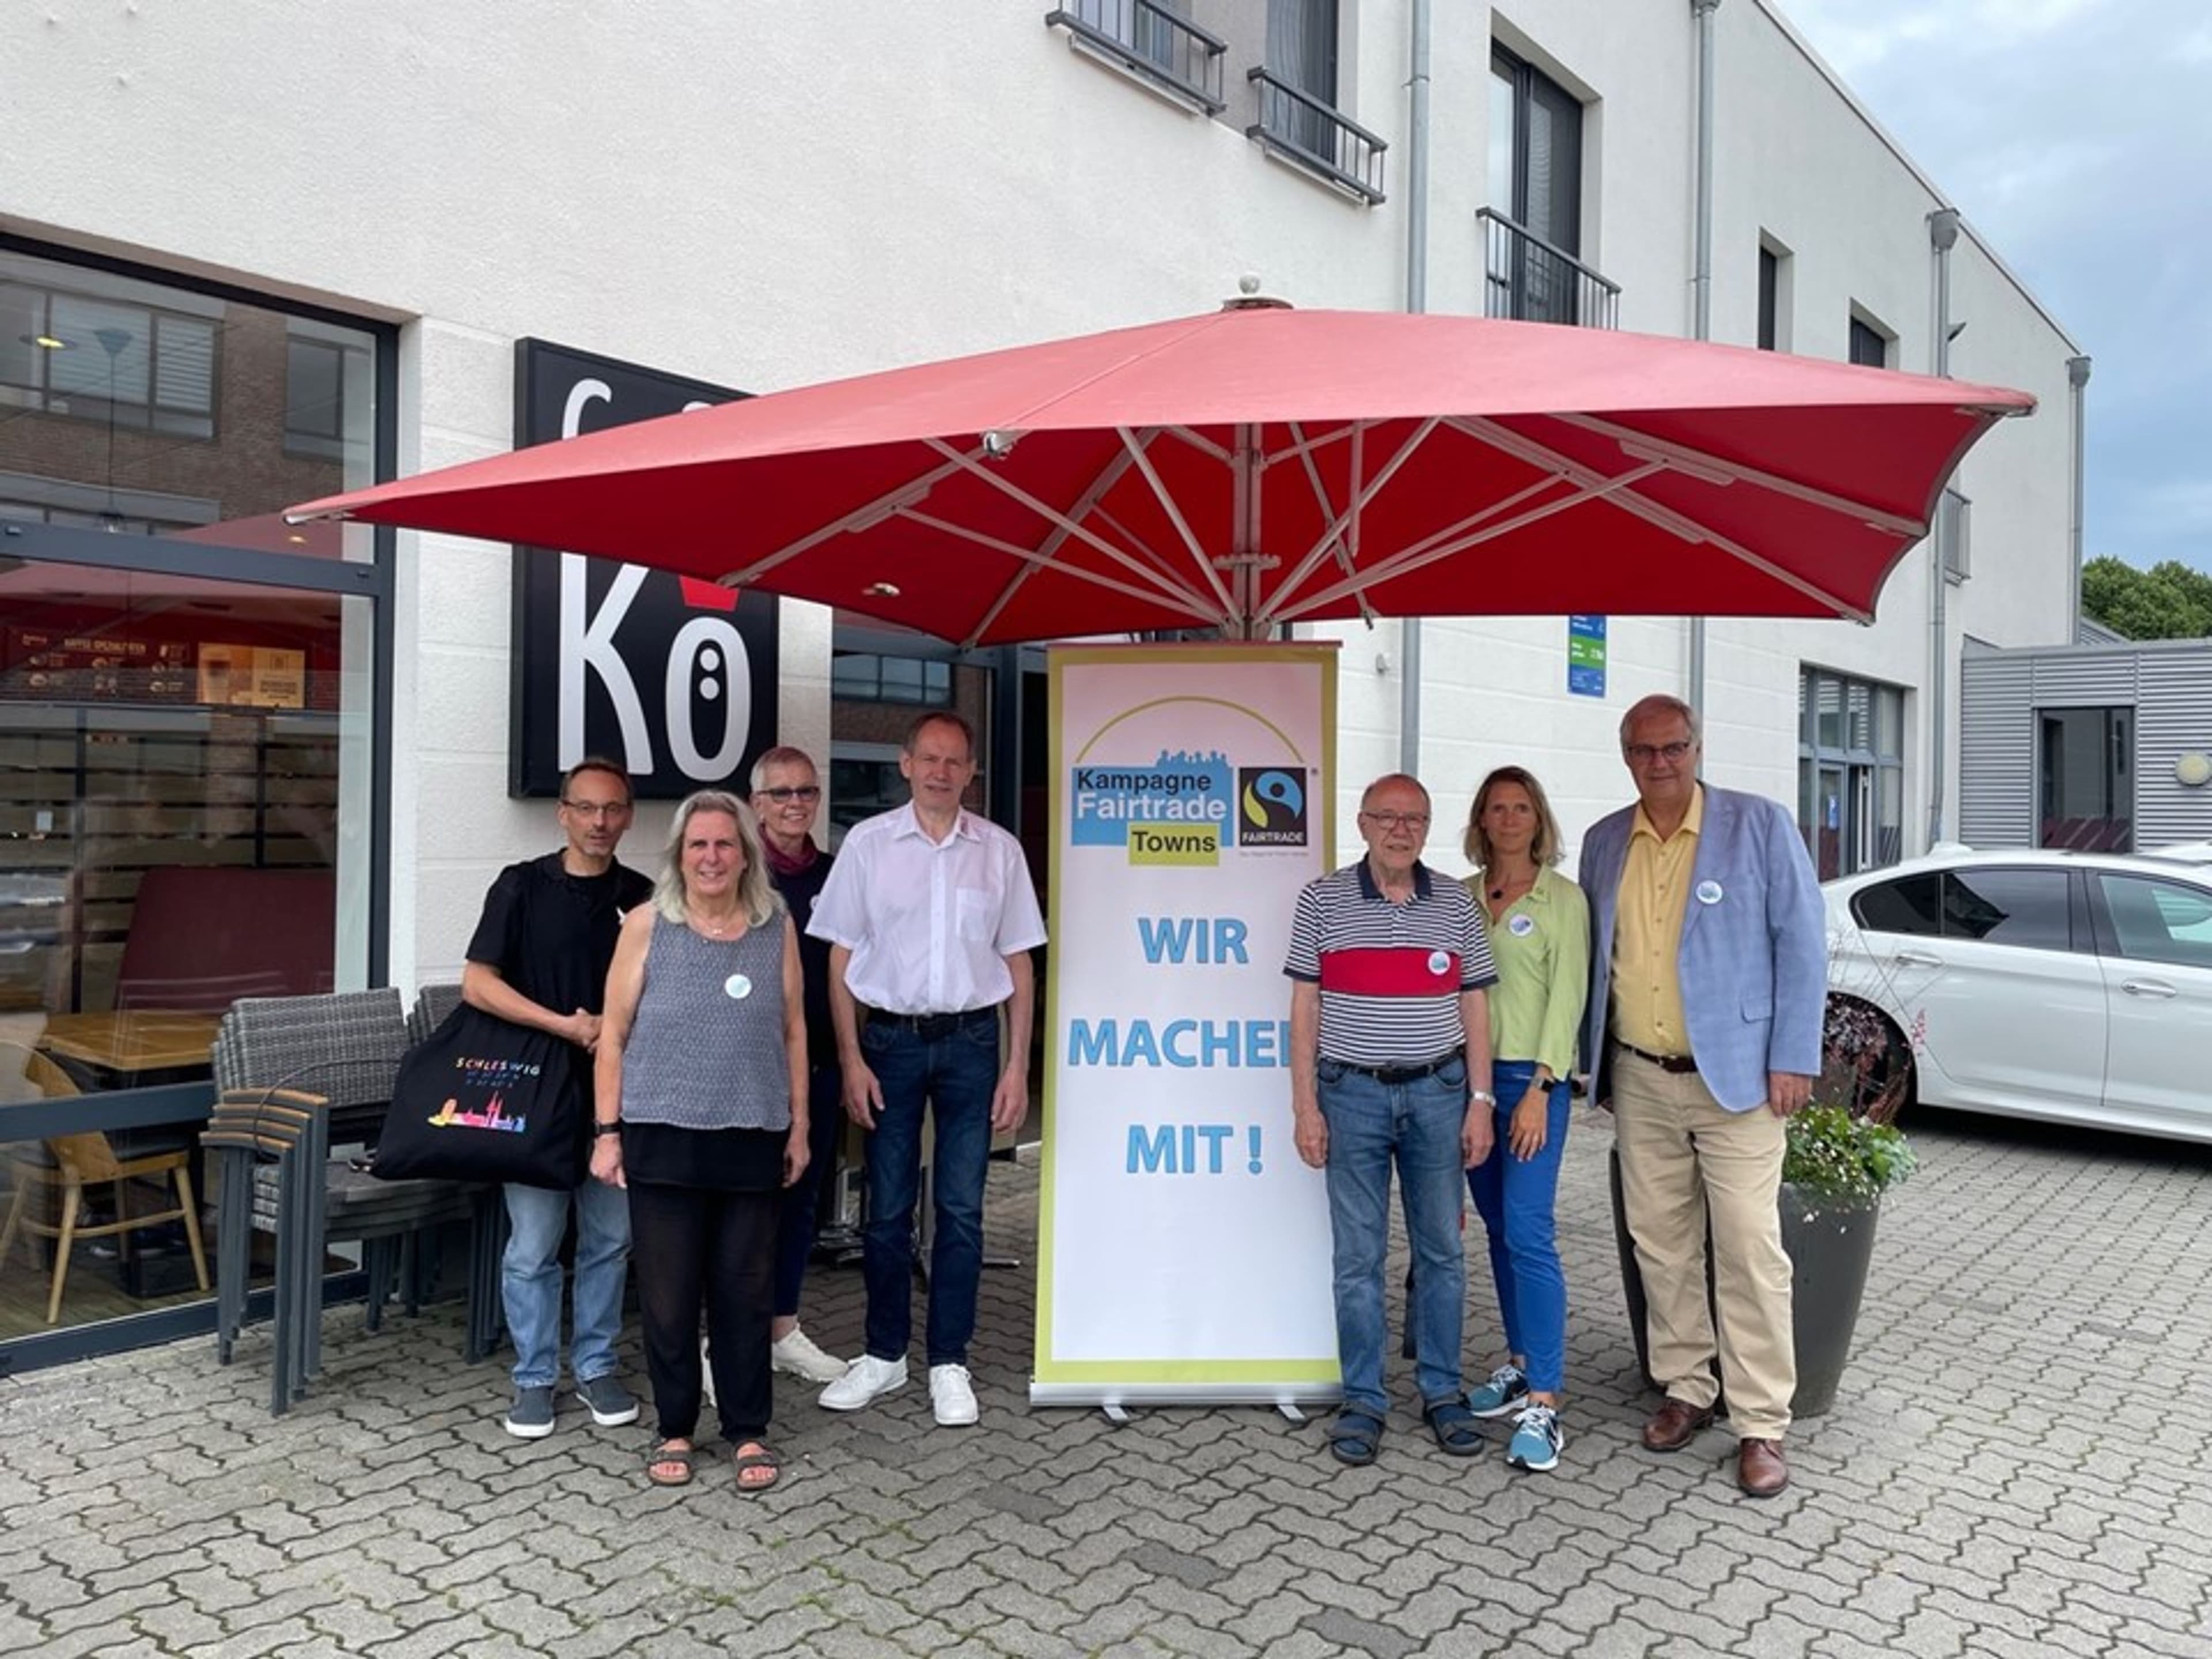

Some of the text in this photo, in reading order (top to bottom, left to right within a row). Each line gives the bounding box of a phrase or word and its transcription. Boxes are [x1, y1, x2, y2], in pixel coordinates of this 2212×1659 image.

[1077, 769, 1211, 796] Kampagne
[1077, 792, 1226, 820] Fairtrade
[1132, 831, 1216, 853] Towns
[1242, 831, 1304, 843] FAIRTRADE
[1138, 918, 1249, 964] WIR
[1126, 1125, 1234, 1174] MIT
